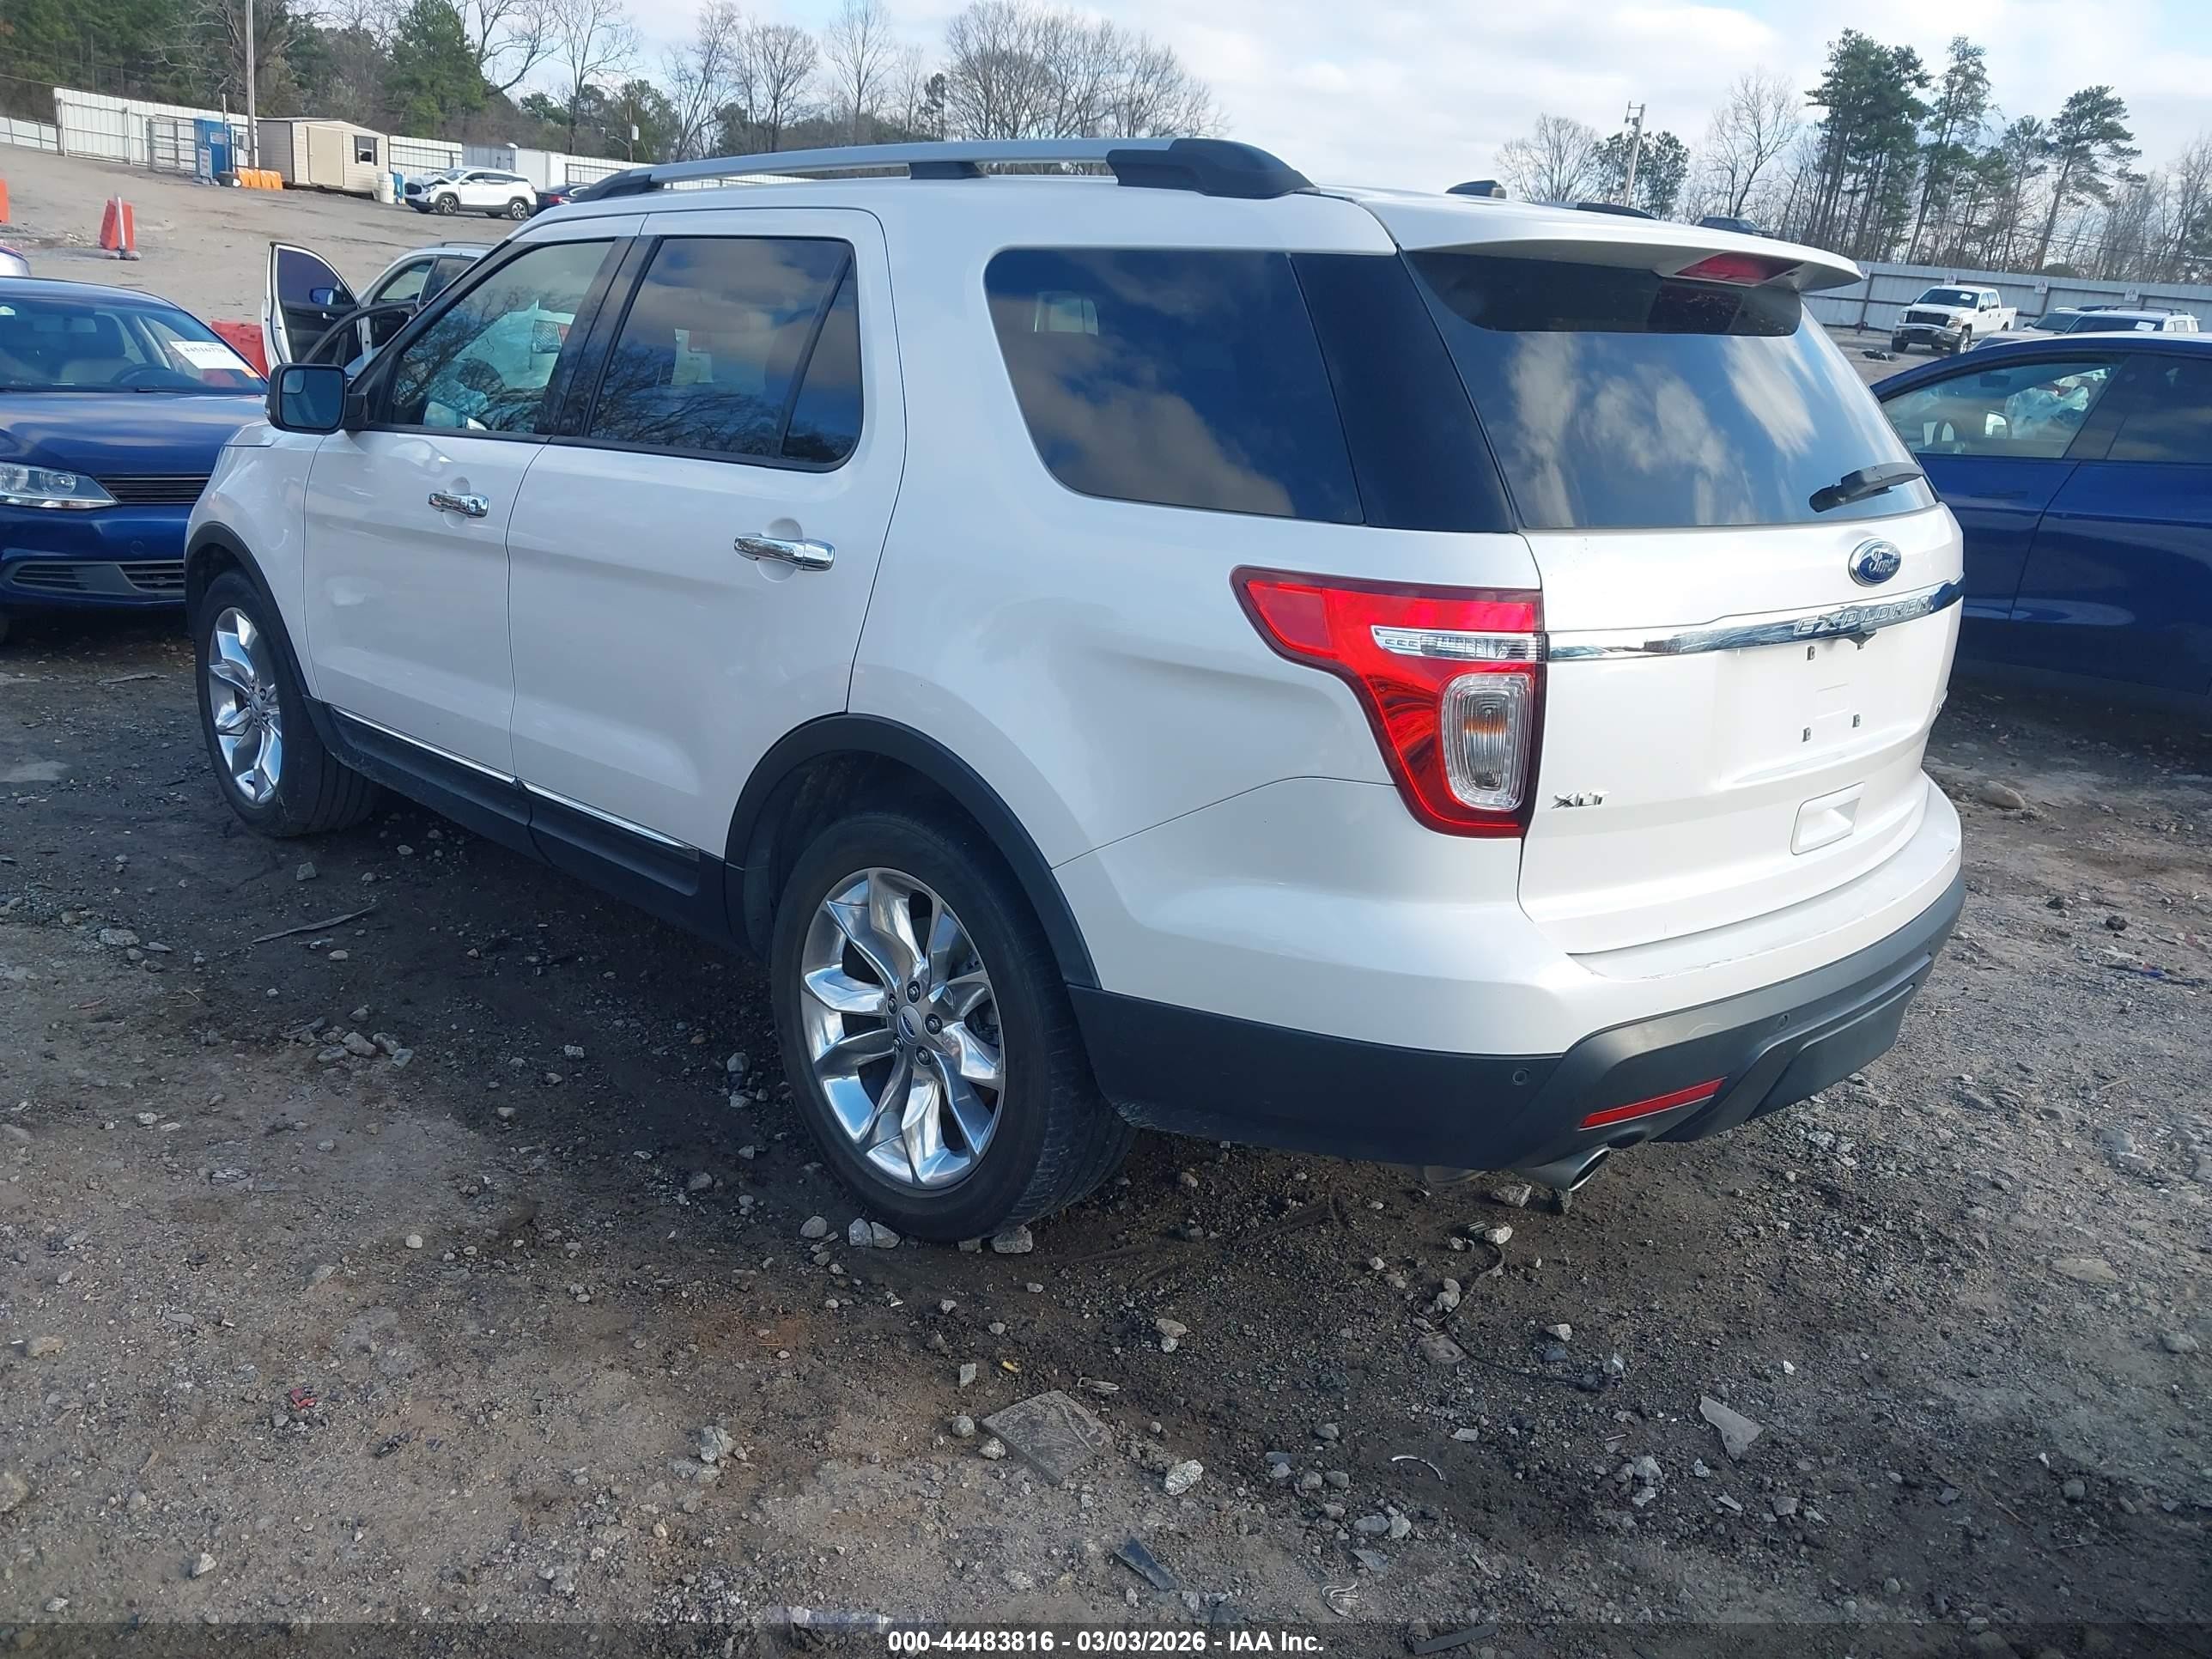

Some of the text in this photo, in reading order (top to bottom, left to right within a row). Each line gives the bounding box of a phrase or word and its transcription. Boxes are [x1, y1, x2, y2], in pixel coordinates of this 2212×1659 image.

[1869, 548, 1898, 574] Ford
[1793, 595, 1930, 634] EXPLORER
[1551, 791, 1608, 808] XLT
